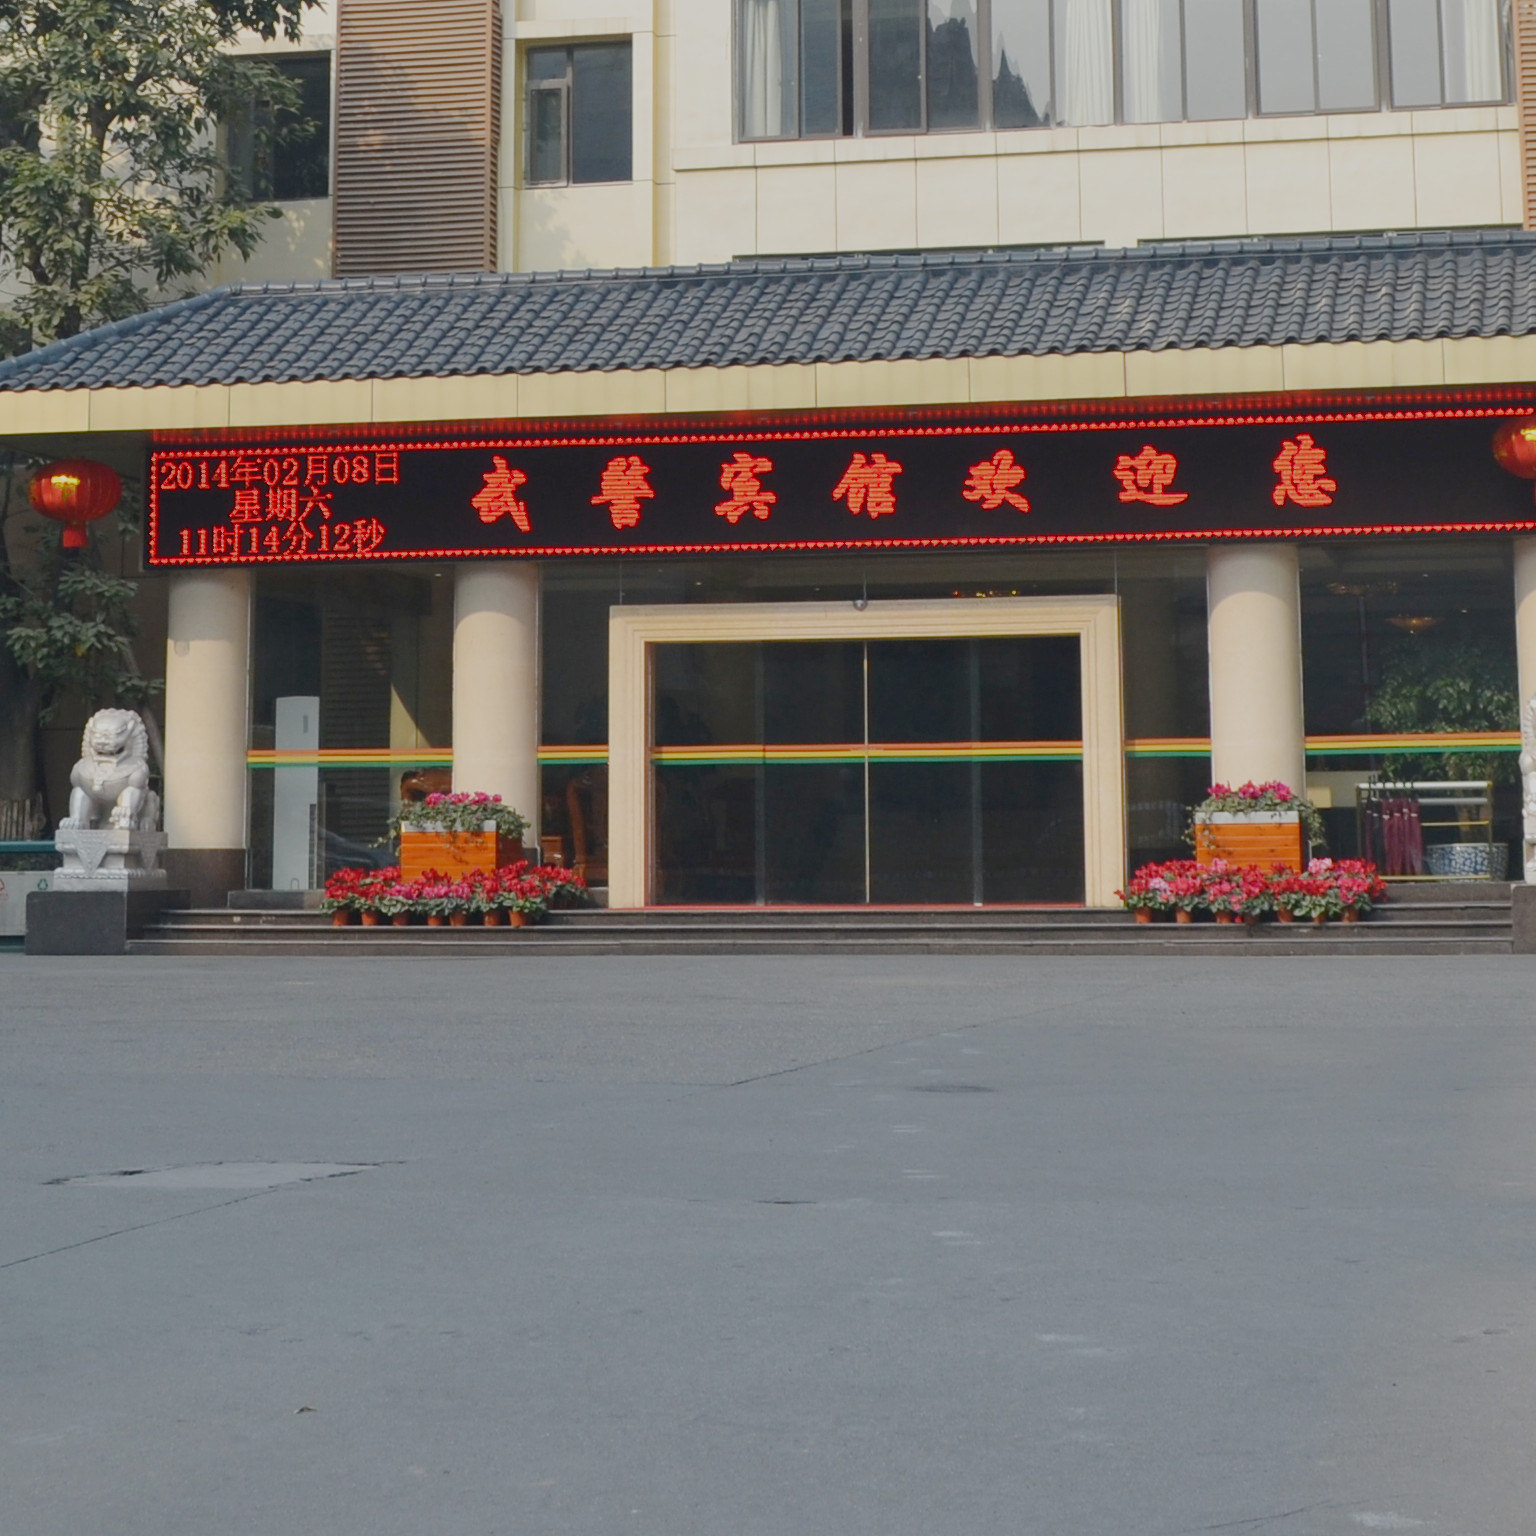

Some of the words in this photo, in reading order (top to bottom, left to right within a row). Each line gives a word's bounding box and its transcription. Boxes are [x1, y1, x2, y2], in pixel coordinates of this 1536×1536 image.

[159, 451, 401, 490] 2014年02月08日
[470, 434, 1337, 534] 武警宾馆欢迎您
[228, 484, 334, 524] 星期六
[178, 516, 387, 556] 11时14分12秒
